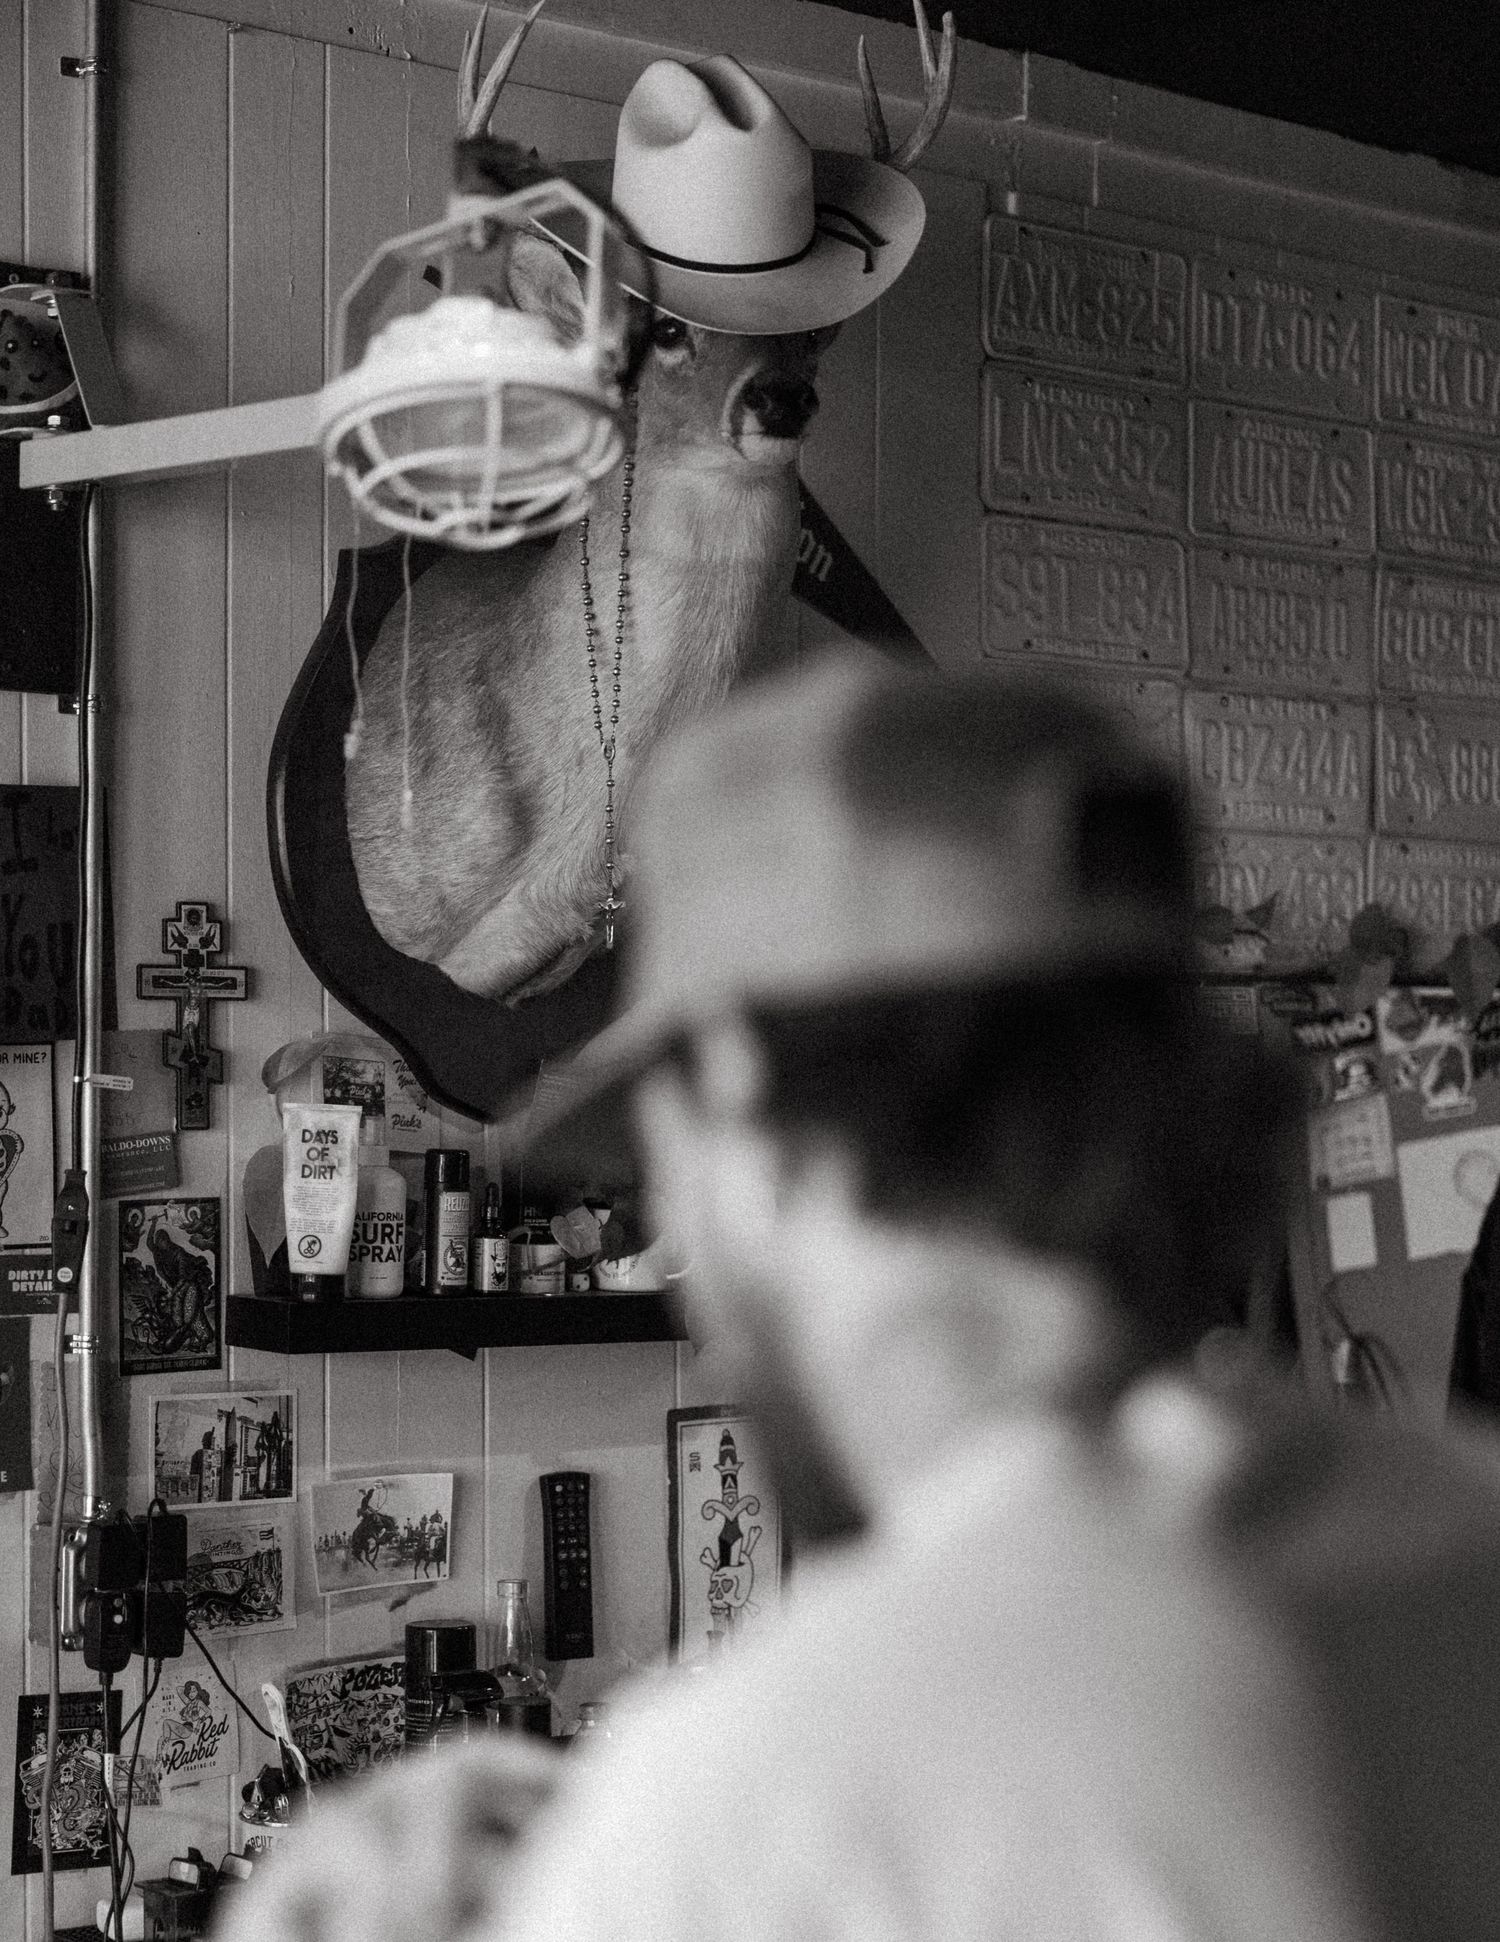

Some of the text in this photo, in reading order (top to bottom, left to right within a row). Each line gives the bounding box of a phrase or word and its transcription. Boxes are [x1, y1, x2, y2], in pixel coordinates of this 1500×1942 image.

[13, 1052, 47, 1064] MINE?
[301, 1128, 338, 1145] DAYS
[306, 1147, 330, 1162] OF
[301, 1164, 336, 1180] DIRT
[8, 1270, 44, 1280] DIRTY
[196, 1713, 230, 1747] Red
[166, 1738, 221, 1775] Rabbit
